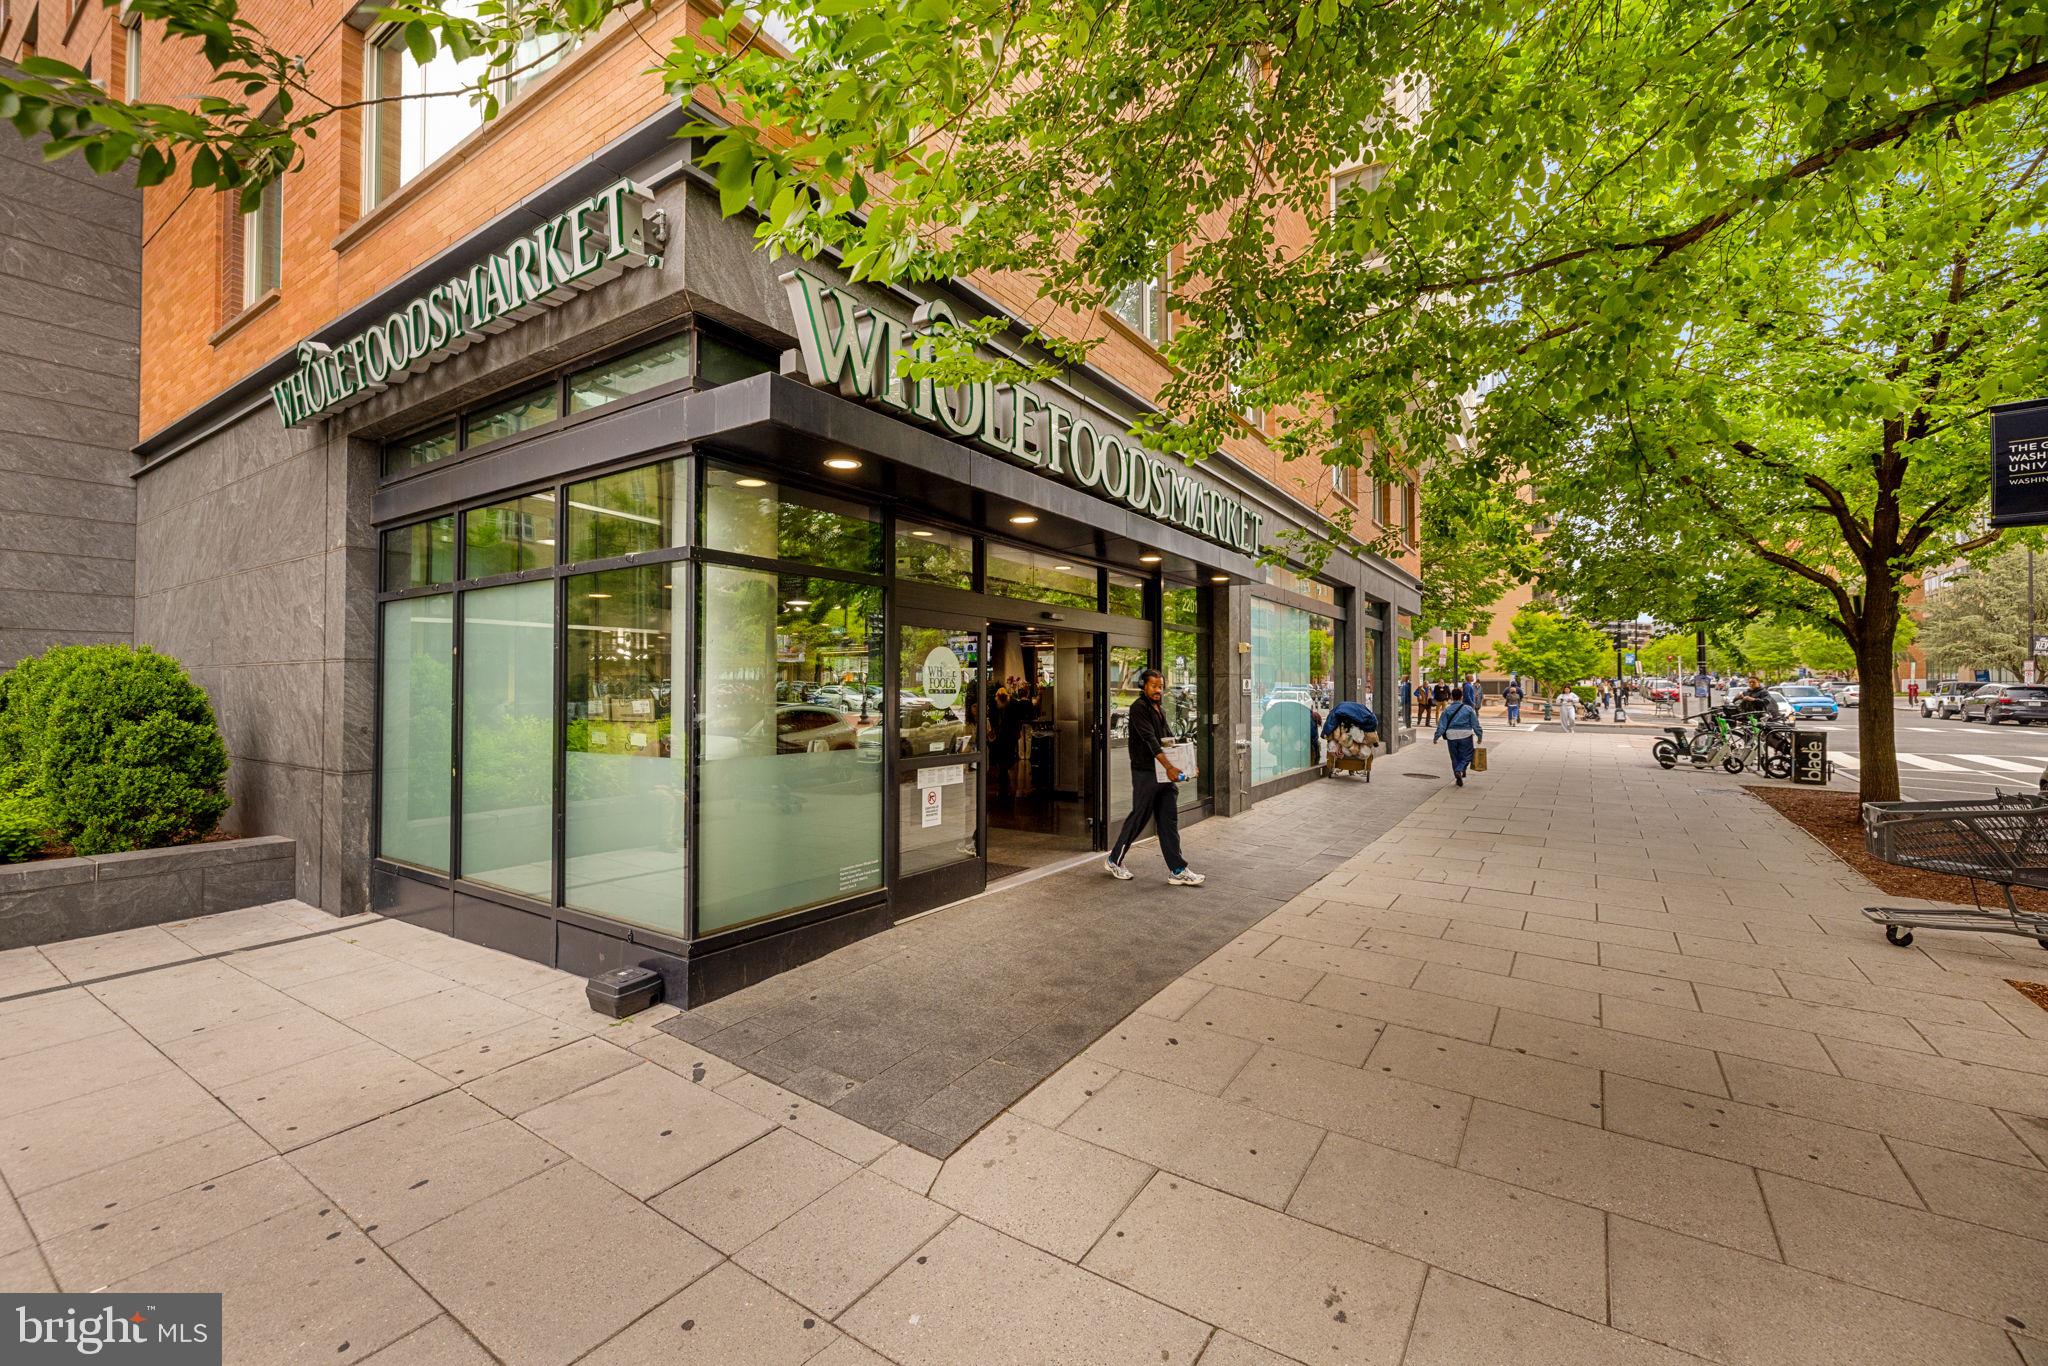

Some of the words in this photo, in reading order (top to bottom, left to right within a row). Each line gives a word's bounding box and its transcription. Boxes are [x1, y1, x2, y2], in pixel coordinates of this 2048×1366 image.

[2009, 442, 2037, 453] THE
[2009, 460, 2048, 472] UNIV
[929, 677, 956, 689] FOODS
[1801, 741, 1822, 781] blade
